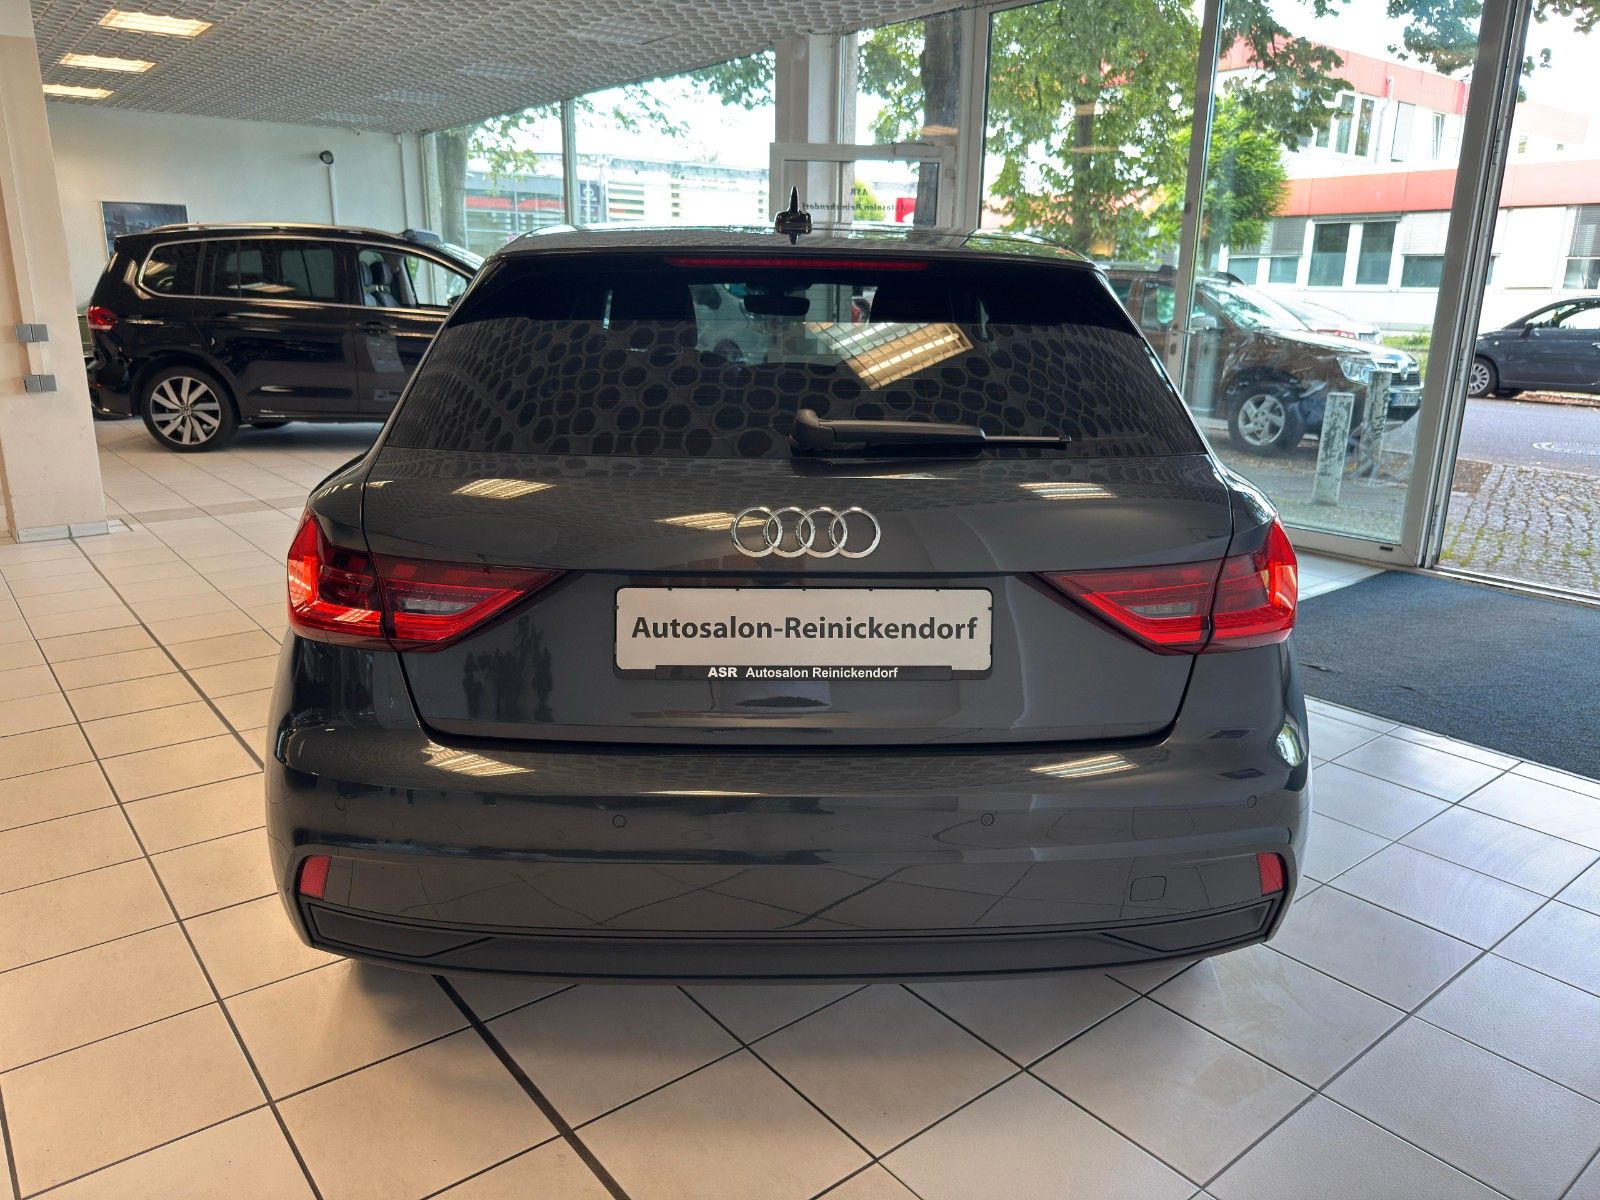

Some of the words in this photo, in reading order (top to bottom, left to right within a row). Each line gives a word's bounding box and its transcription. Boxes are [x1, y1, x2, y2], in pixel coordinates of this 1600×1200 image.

[631, 616, 978, 640] Autosalon-Reinickendorf
[708, 667, 738, 678] ASR
[745, 667, 808, 678] Autosalon
[812, 667, 899, 678] Reinickendorf
